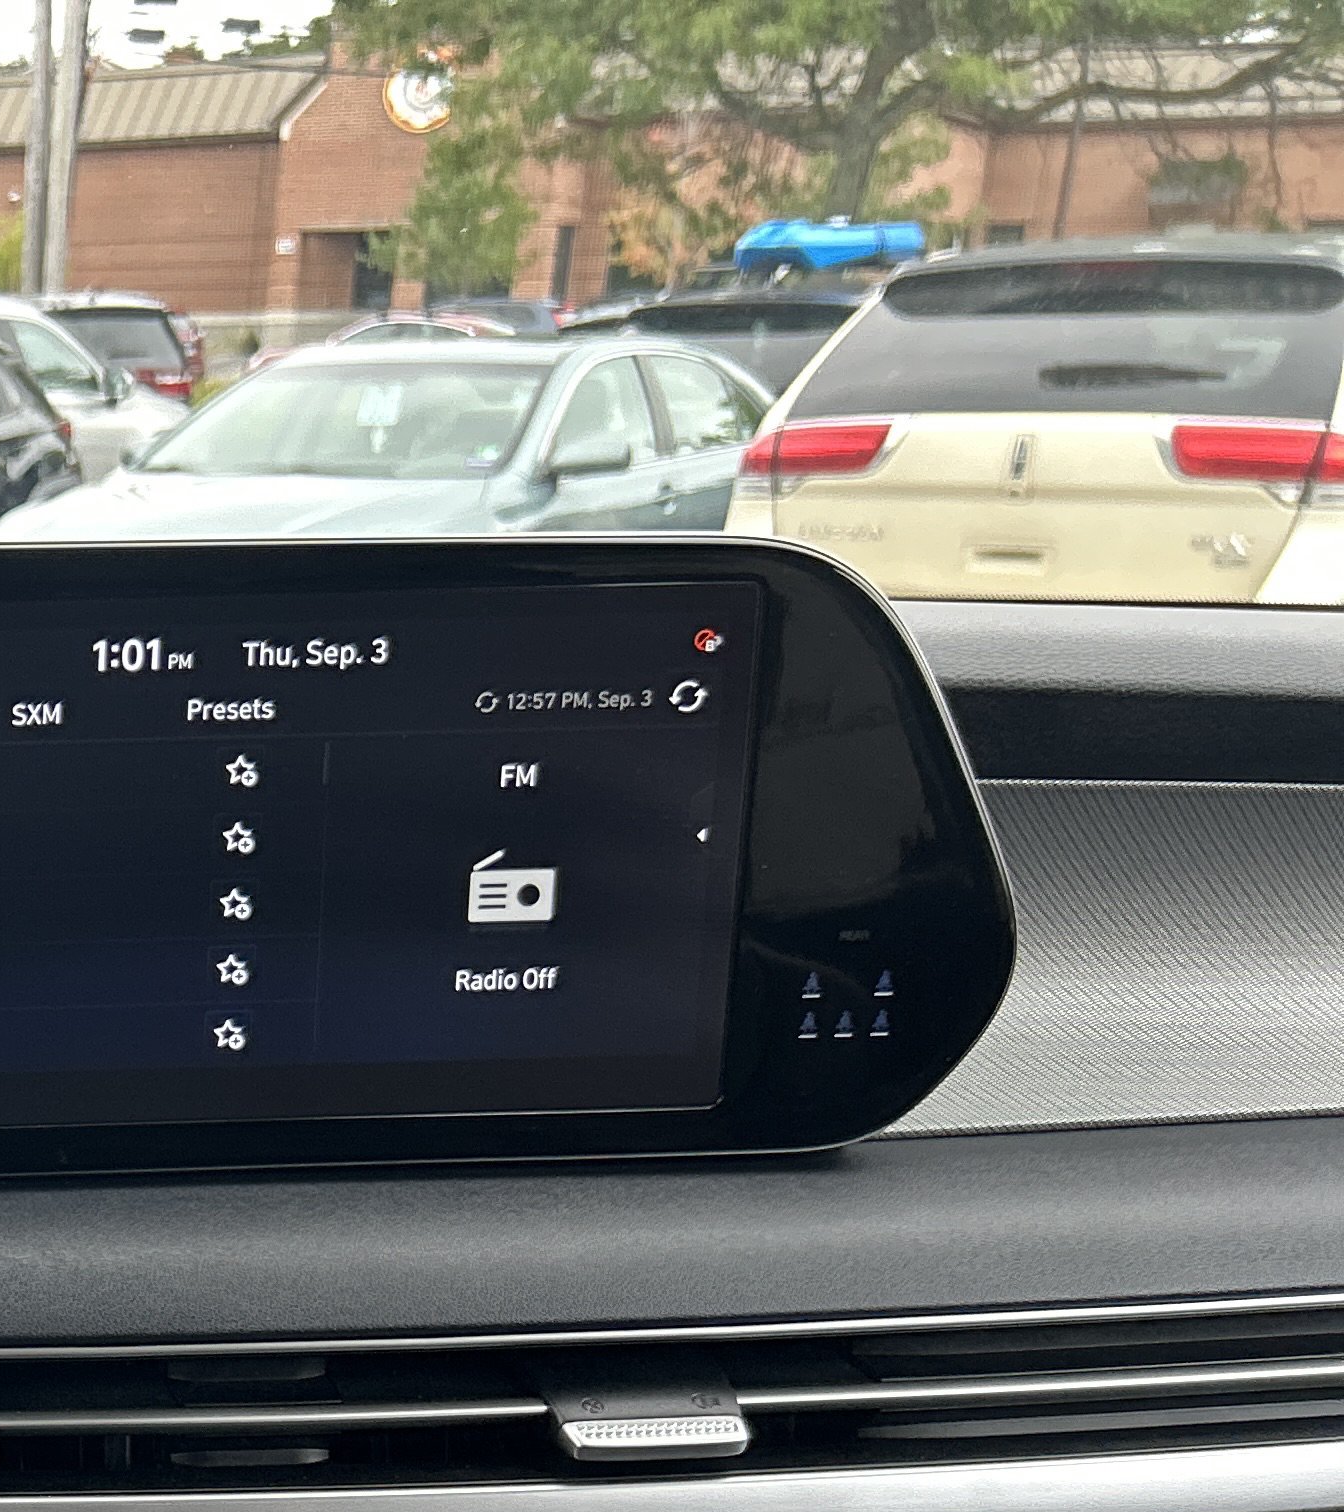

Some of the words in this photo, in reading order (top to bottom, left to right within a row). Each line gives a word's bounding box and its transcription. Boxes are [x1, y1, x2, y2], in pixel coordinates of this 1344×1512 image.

[93, 638, 161, 671] 1:01
[168, 653, 193, 669] PM
[243, 640, 298, 668] Thu,
[306, 639, 363, 669] Sep.
[371, 637, 388, 663] 3
[187, 699, 275, 720] Presets
[508, 693, 556, 709] 12:57
[562, 692, 592, 708] PM,
[598, 691, 635, 710] Sep.
[641, 690, 652, 706] 3
[12, 702, 62, 725] SXM
[501, 763, 537, 787] FM
[456, 968, 513, 991] Radio
[523, 967, 558, 989] Off
